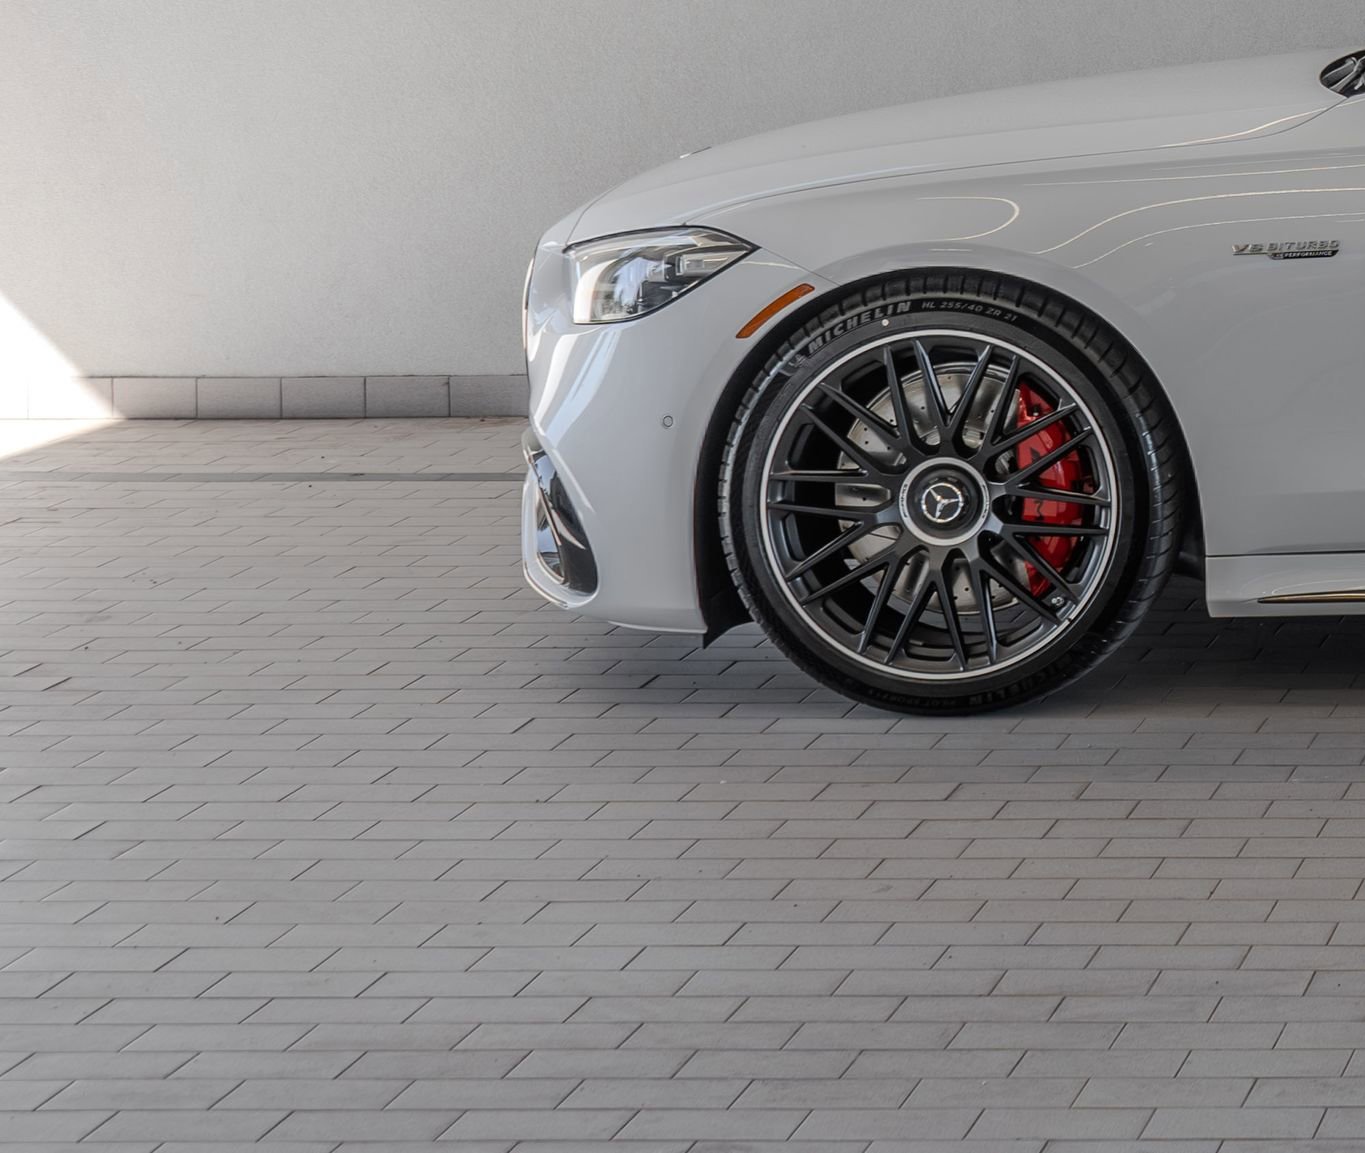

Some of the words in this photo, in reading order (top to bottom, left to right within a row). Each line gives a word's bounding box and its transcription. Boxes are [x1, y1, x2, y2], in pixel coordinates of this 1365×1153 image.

[808, 301, 911, 354] MICHELIN
[922, 302, 936, 310] HL
[940, 302, 982, 313] 255/40
[985, 307, 1001, 317] ZR
[1004, 314, 1017, 322] 21
